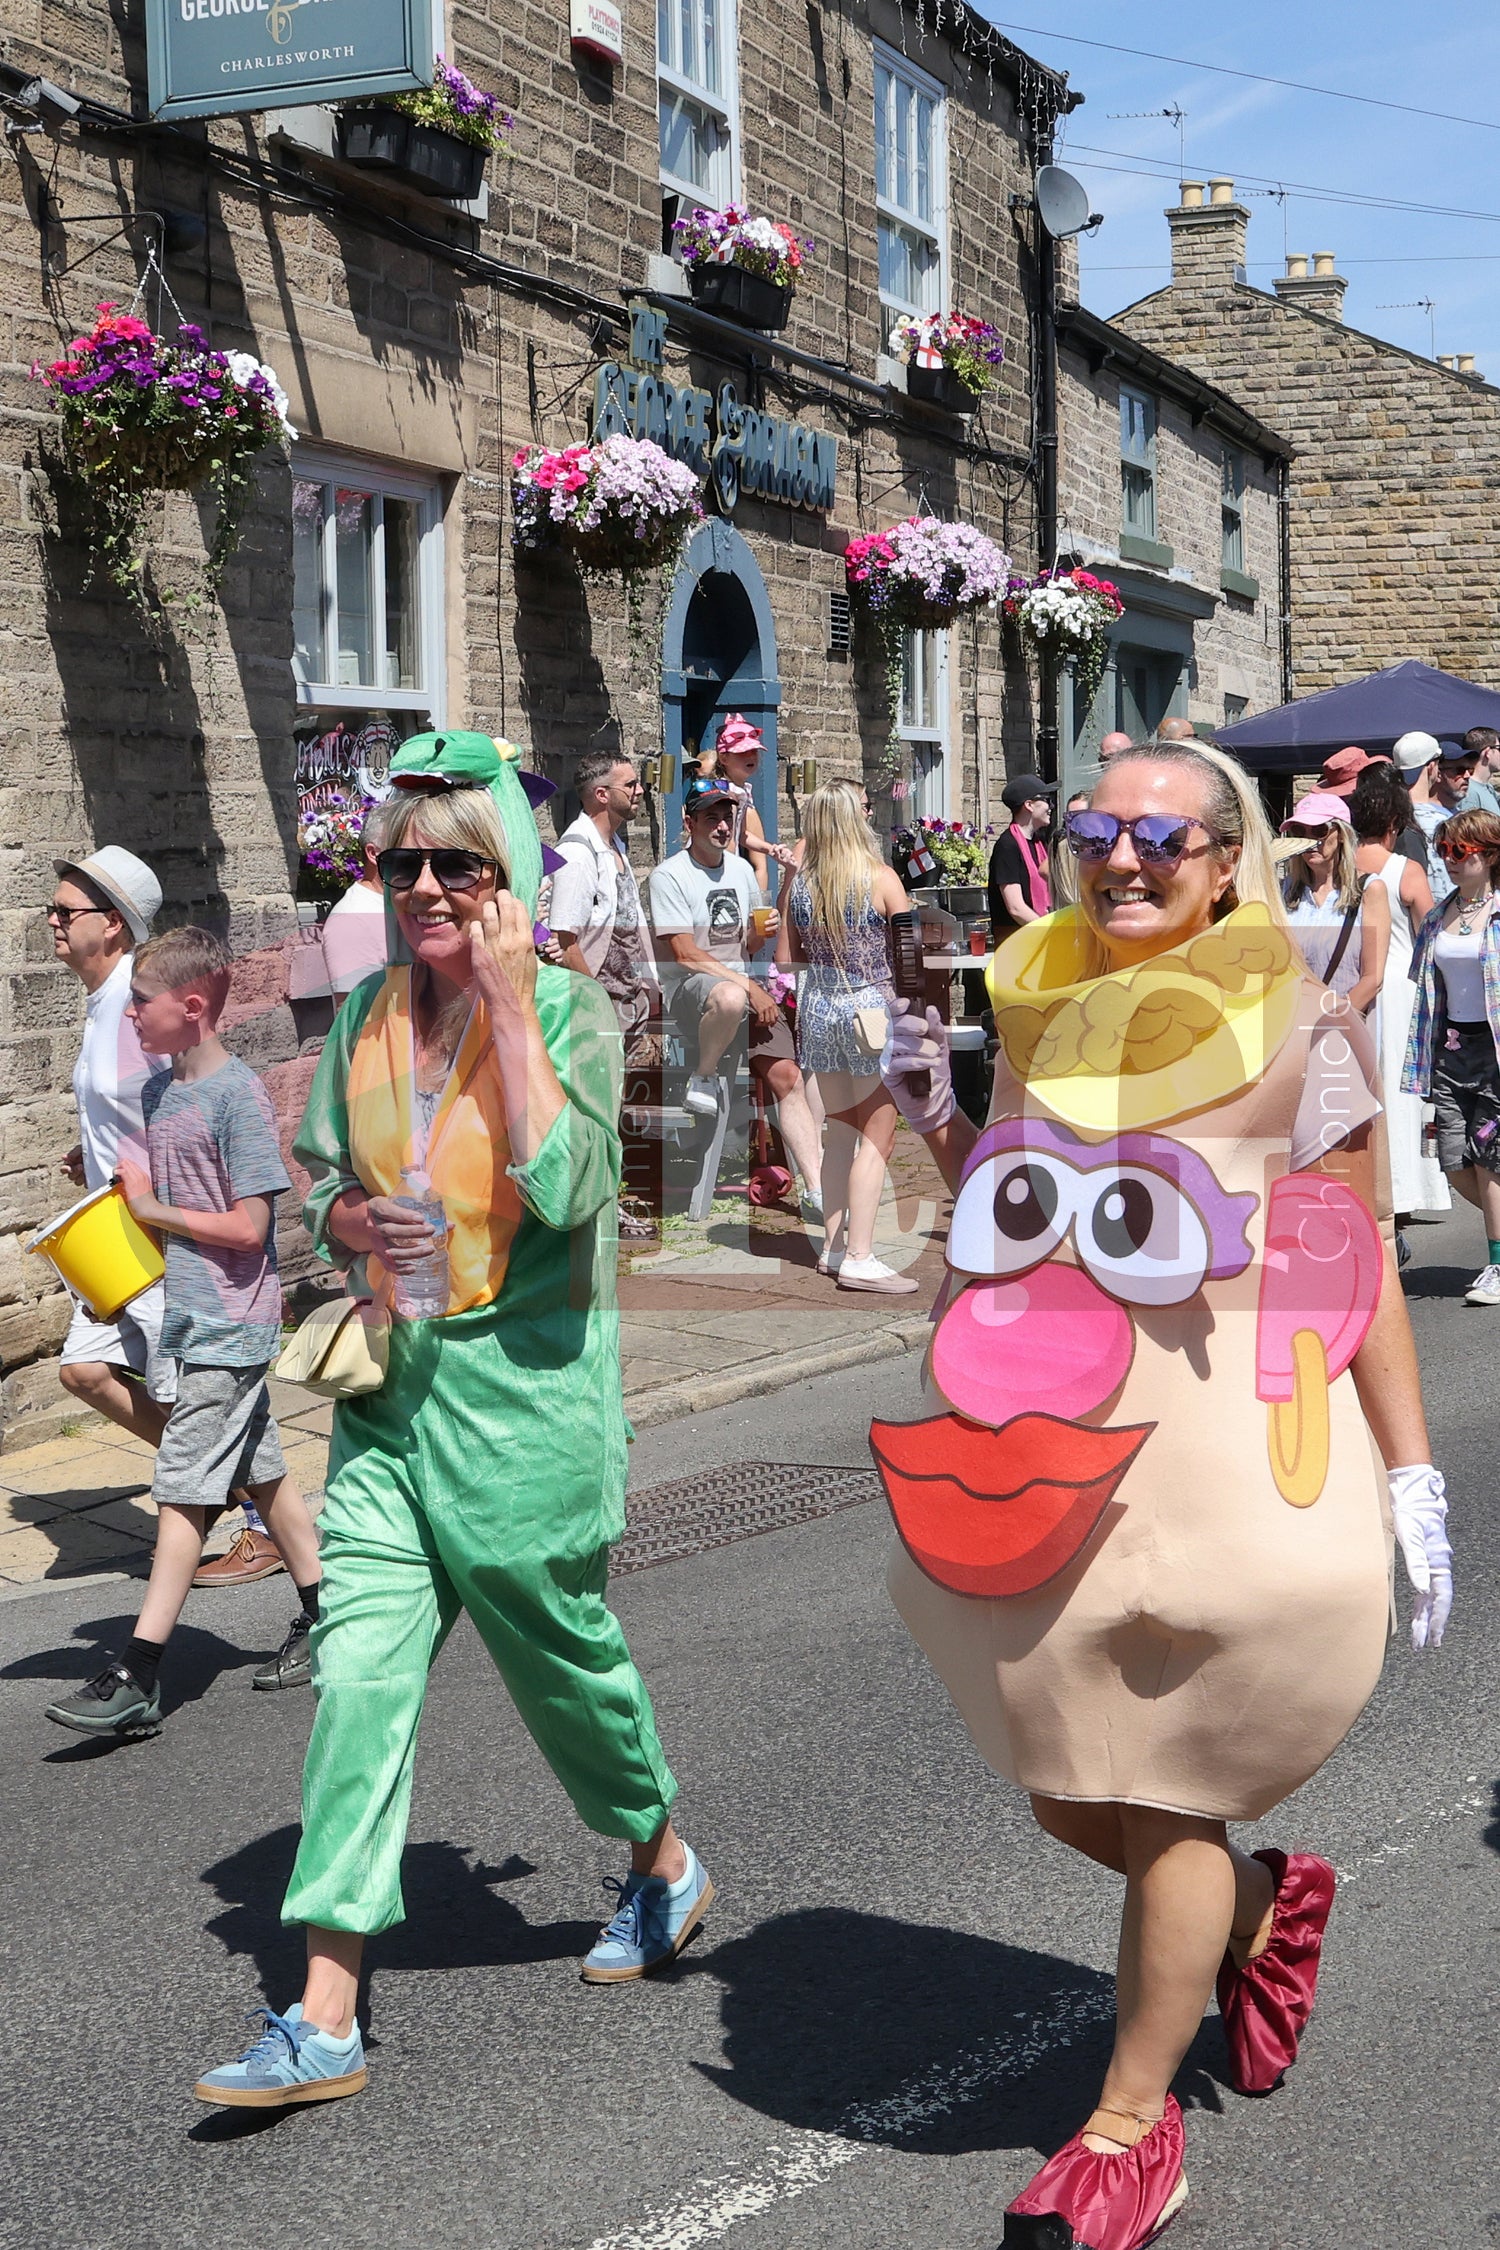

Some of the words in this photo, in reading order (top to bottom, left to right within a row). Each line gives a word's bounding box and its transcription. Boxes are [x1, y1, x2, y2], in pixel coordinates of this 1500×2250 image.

[220, 45, 355, 73] CHARLESWORTH
[630, 303, 671, 365] THE
[742, 407, 838, 509] DRAGON
